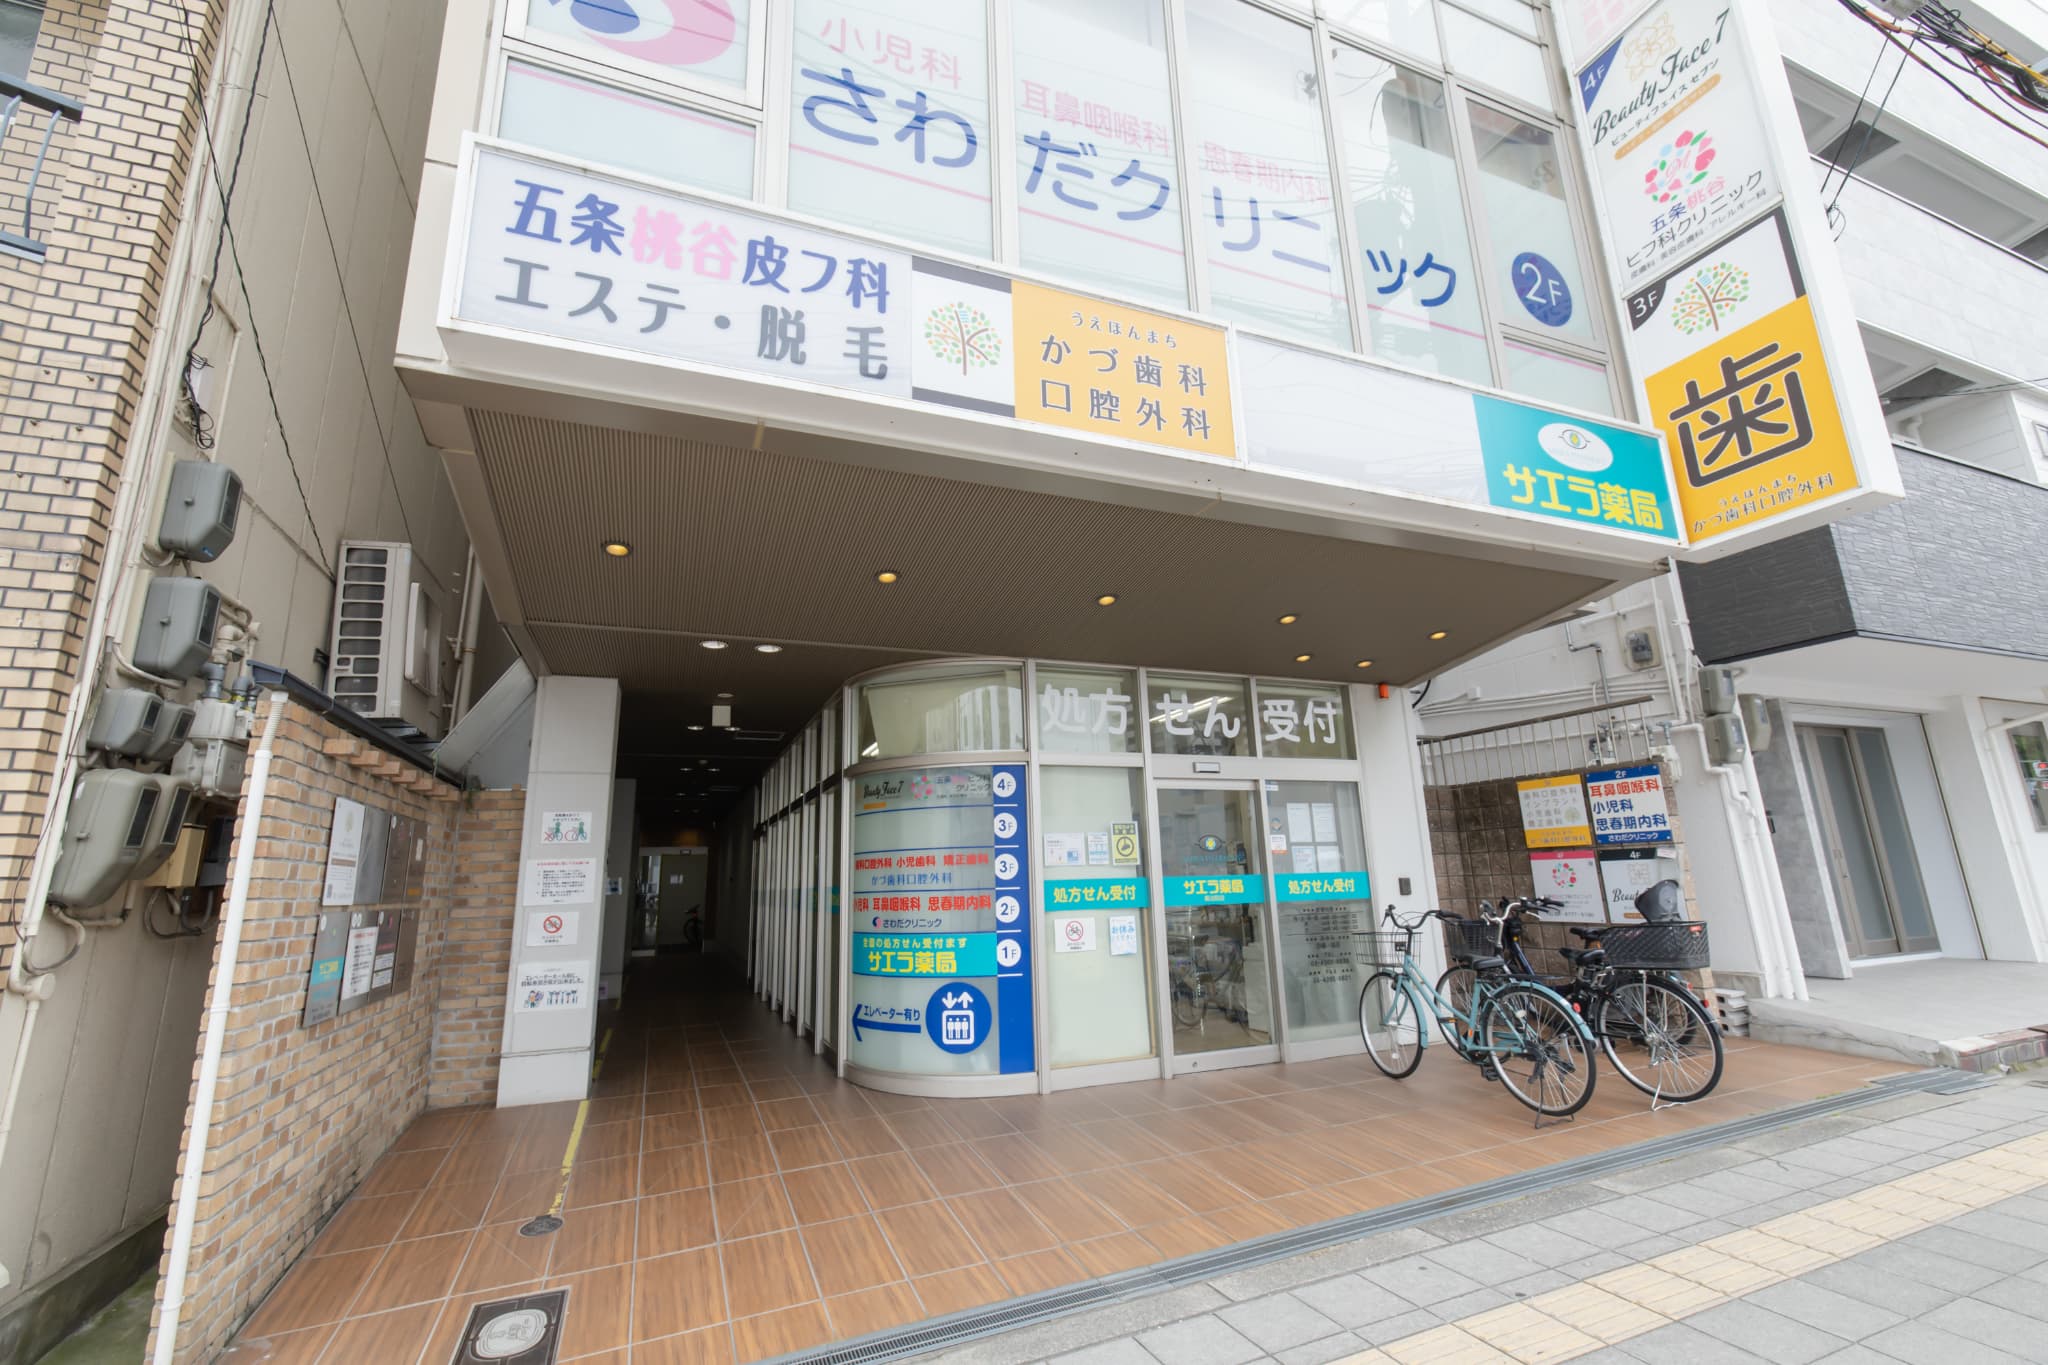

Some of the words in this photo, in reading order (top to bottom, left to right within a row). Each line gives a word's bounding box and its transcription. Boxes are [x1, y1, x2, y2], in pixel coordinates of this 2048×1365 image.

[1583, 64, 1606, 92] 4F
[1593, 78, 1659, 146] Beauty
[1658, 38, 1711, 94] Face
[1714, 7, 1730, 45] 7
[820, 16, 962, 90] 小児科
[1021, 78, 1171, 158] 耳鼻咽喉科
[1204, 140, 1330, 204] 思春期内科
[1650, 175, 1726, 235] 五条桃谷
[505, 178, 890, 314] 五条桃谷皮フ科
[1519, 263, 1562, 309] 2F
[1633, 289, 1660, 319] 3F
[1070, 310, 1178, 351] うえほんまち
[1040, 333, 1208, 397] かづ歯科
[1040, 378, 1212, 441] 口腔外科
[1667, 342, 1815, 489] 歯
[1502, 463, 1664, 531] サエラ薬局
[1040, 683, 1338, 744] 処方せん受付
[1615, 770, 1628, 779] 2F
[996, 778, 1013, 792] 4F
[1590, 779, 1661, 798] 耳鼻咽喉科
[1593, 798, 1634, 814] 小児科
[997, 819, 1014, 832] 3F
[1595, 813, 1667, 832] 思春期内科
[1608, 832, 1659, 842] さわだクリニック
[895, 855, 937, 869] 小児歯科
[1629, 851, 1642, 859] 4F
[999, 860, 1015, 873] 3F
[871, 872, 952, 886] かづ歯科口腔外科
[1183, 879, 1244, 895] サエラ薬局
[1287, 877, 1355, 895] 処方せん受付
[872, 895, 921, 913] 耳鼻咽喉科
[927, 894, 992, 912] 思春期内科
[1053, 884, 1137, 904] 処方せん受付
[1612, 887, 1640, 904] Beaut
[1000, 903, 1016, 916] 2F
[882, 917, 943, 929] さわだクリニック
[1001, 946, 1017, 959] 1F
[868, 951, 957, 974] サエラ薬局
[863, 1004, 921, 1022] エレベーター有り
